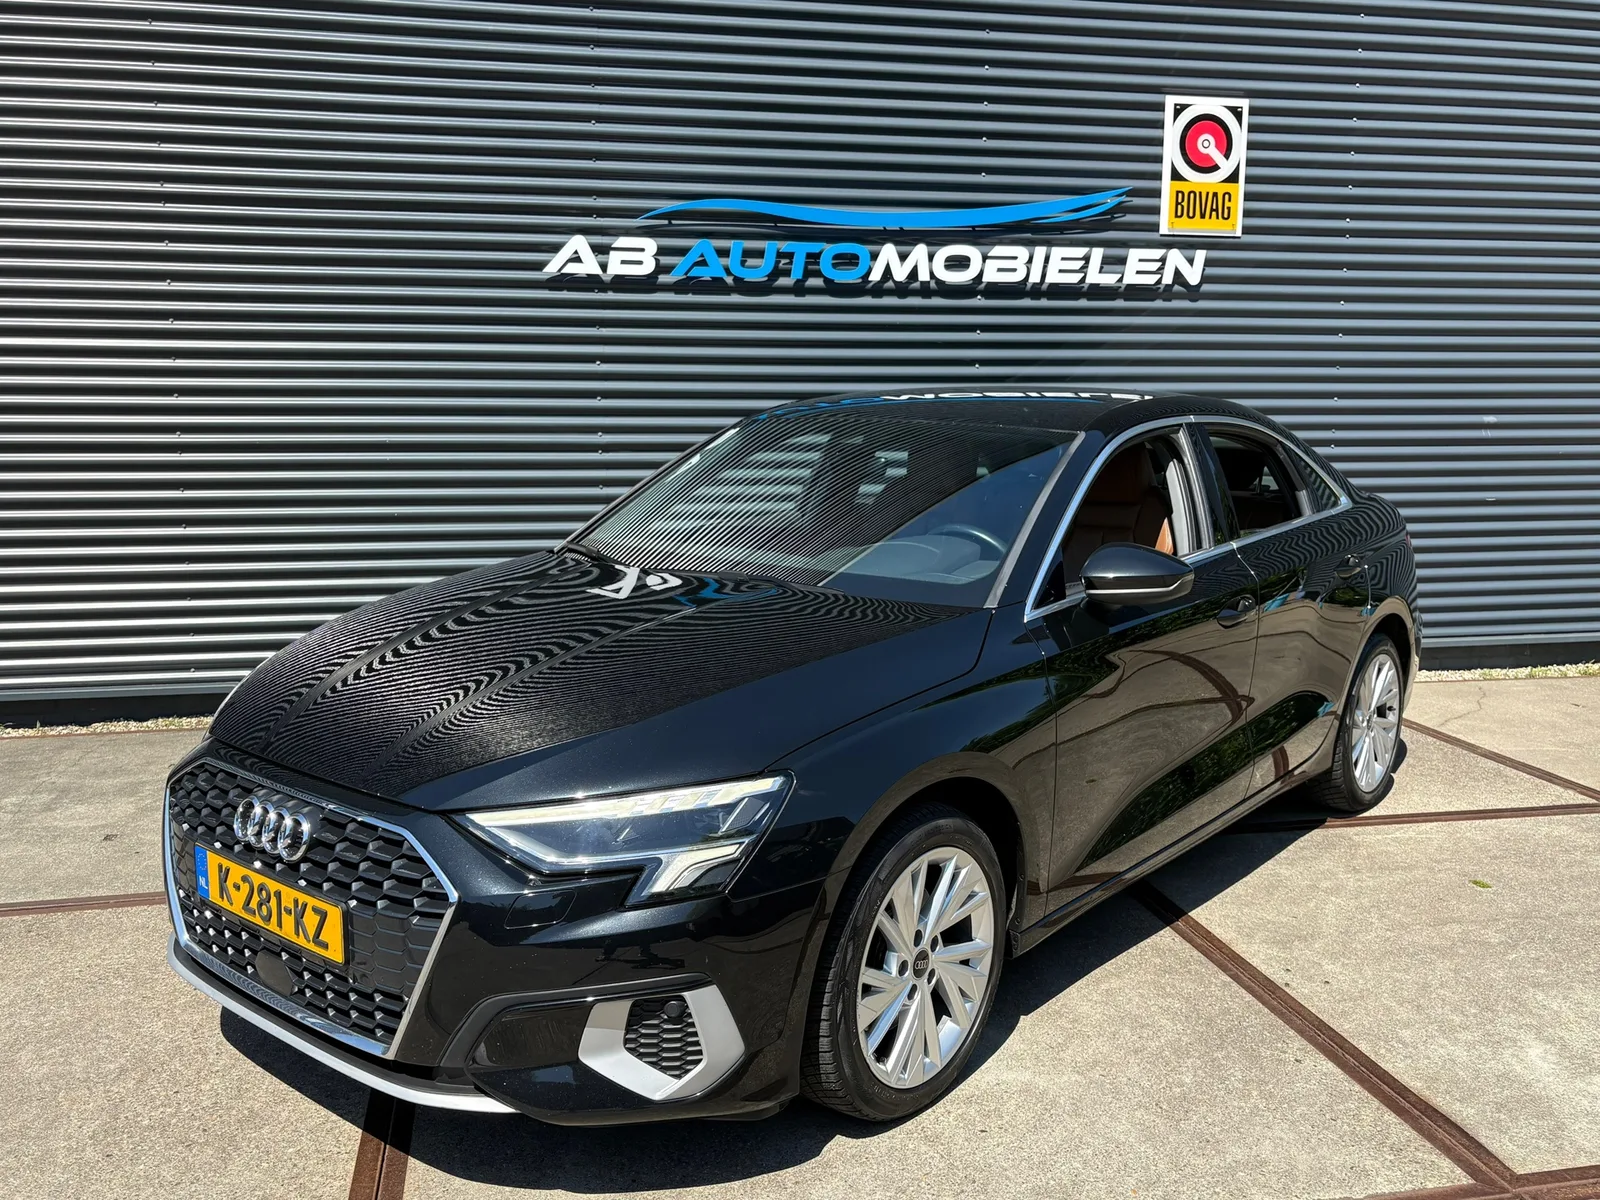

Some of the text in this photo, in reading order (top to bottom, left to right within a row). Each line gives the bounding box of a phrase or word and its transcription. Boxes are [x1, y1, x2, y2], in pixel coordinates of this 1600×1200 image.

[1174, 190, 1232, 221] BOVAG
[542, 234, 1207, 286] AB AUTOMOBIELEN
[199, 876, 209, 889] NL
[218, 863, 329, 951] K-281-KZ
